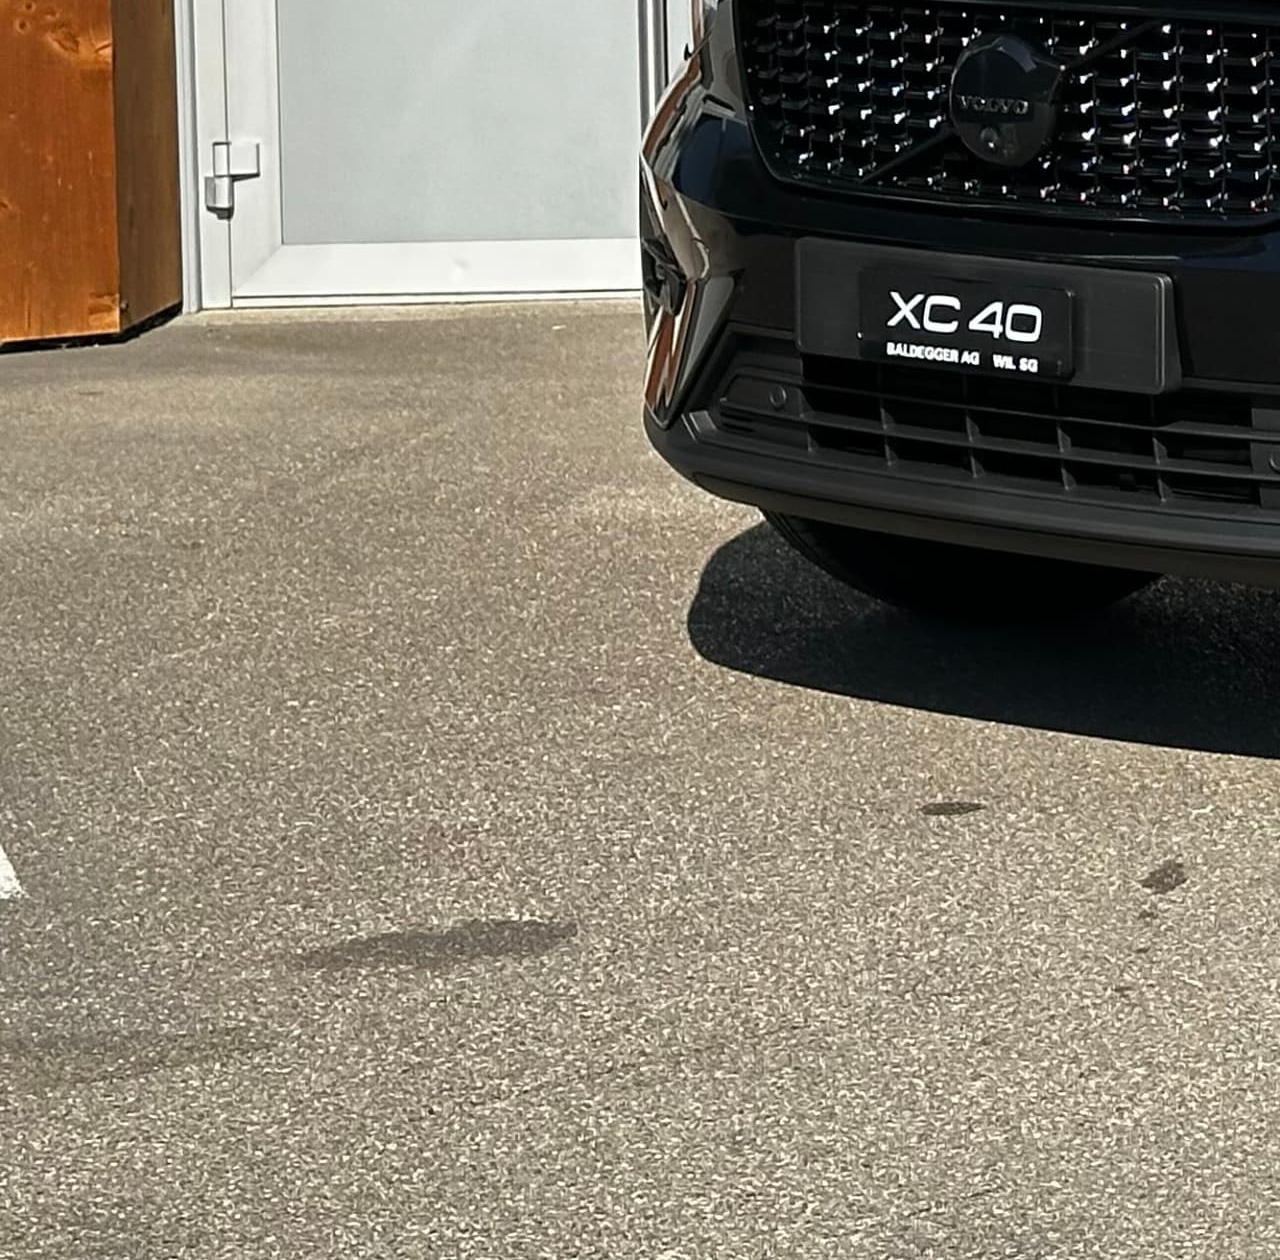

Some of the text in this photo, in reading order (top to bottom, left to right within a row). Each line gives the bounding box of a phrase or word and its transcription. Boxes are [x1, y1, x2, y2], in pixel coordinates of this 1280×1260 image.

[886, 291, 1042, 342] XC 40
[886, 342, 1039, 373] BALDEGGER AG WIL SG
